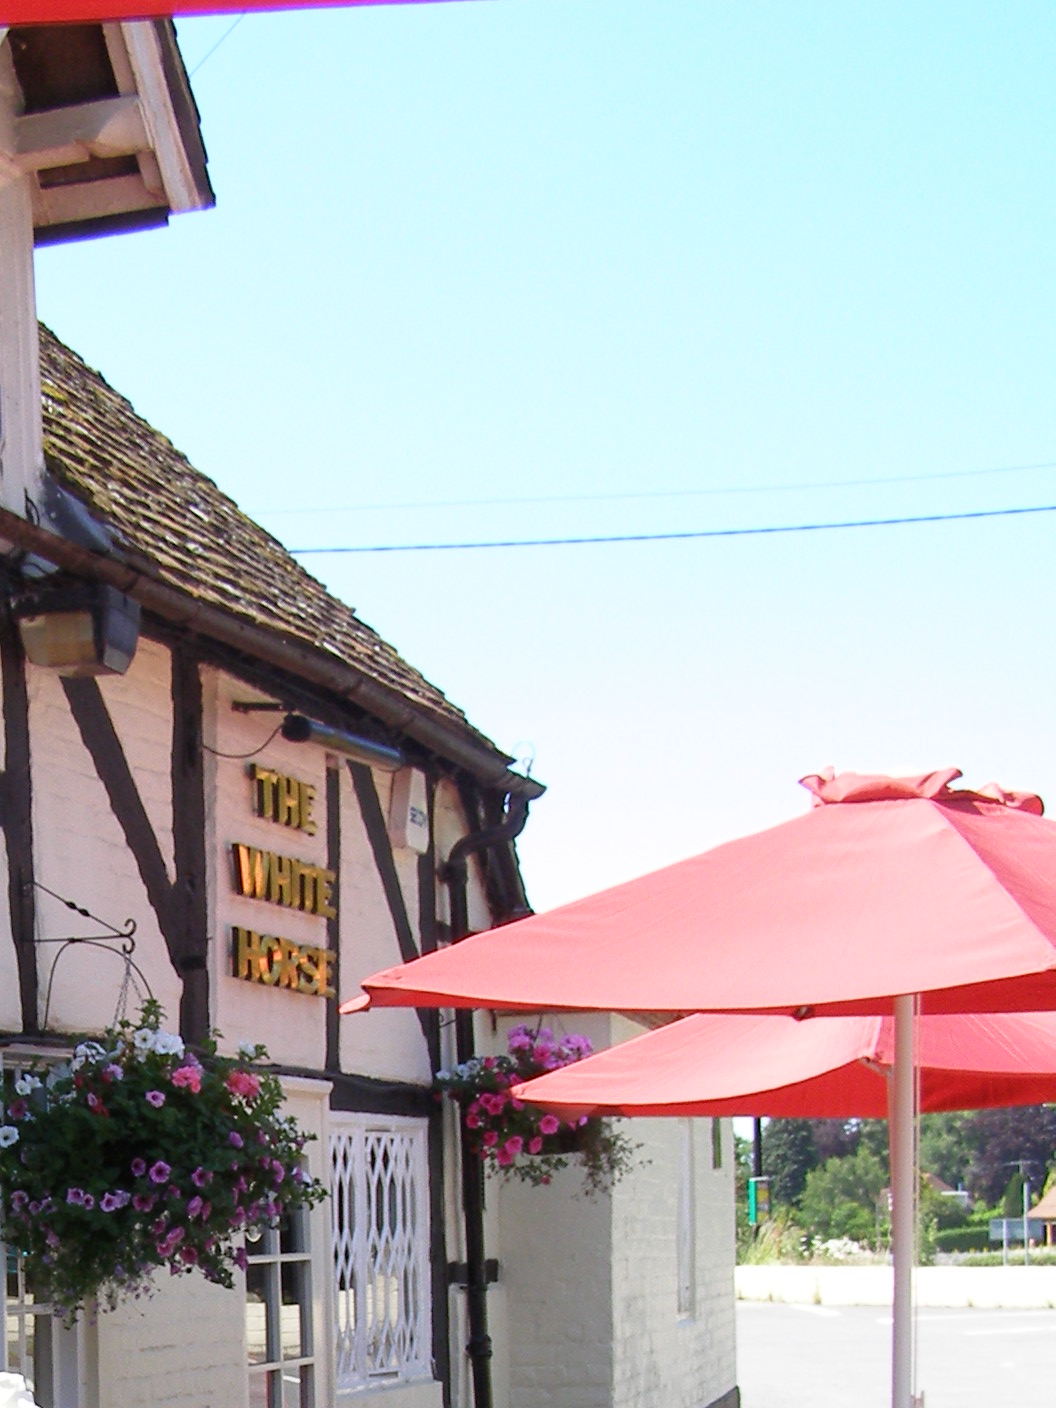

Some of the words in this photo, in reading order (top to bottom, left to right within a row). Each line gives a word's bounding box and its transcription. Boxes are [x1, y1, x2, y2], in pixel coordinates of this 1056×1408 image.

[250, 763, 317, 836] THE
[231, 843, 336, 919] WHITE
[231, 926, 336, 999] HORSE
